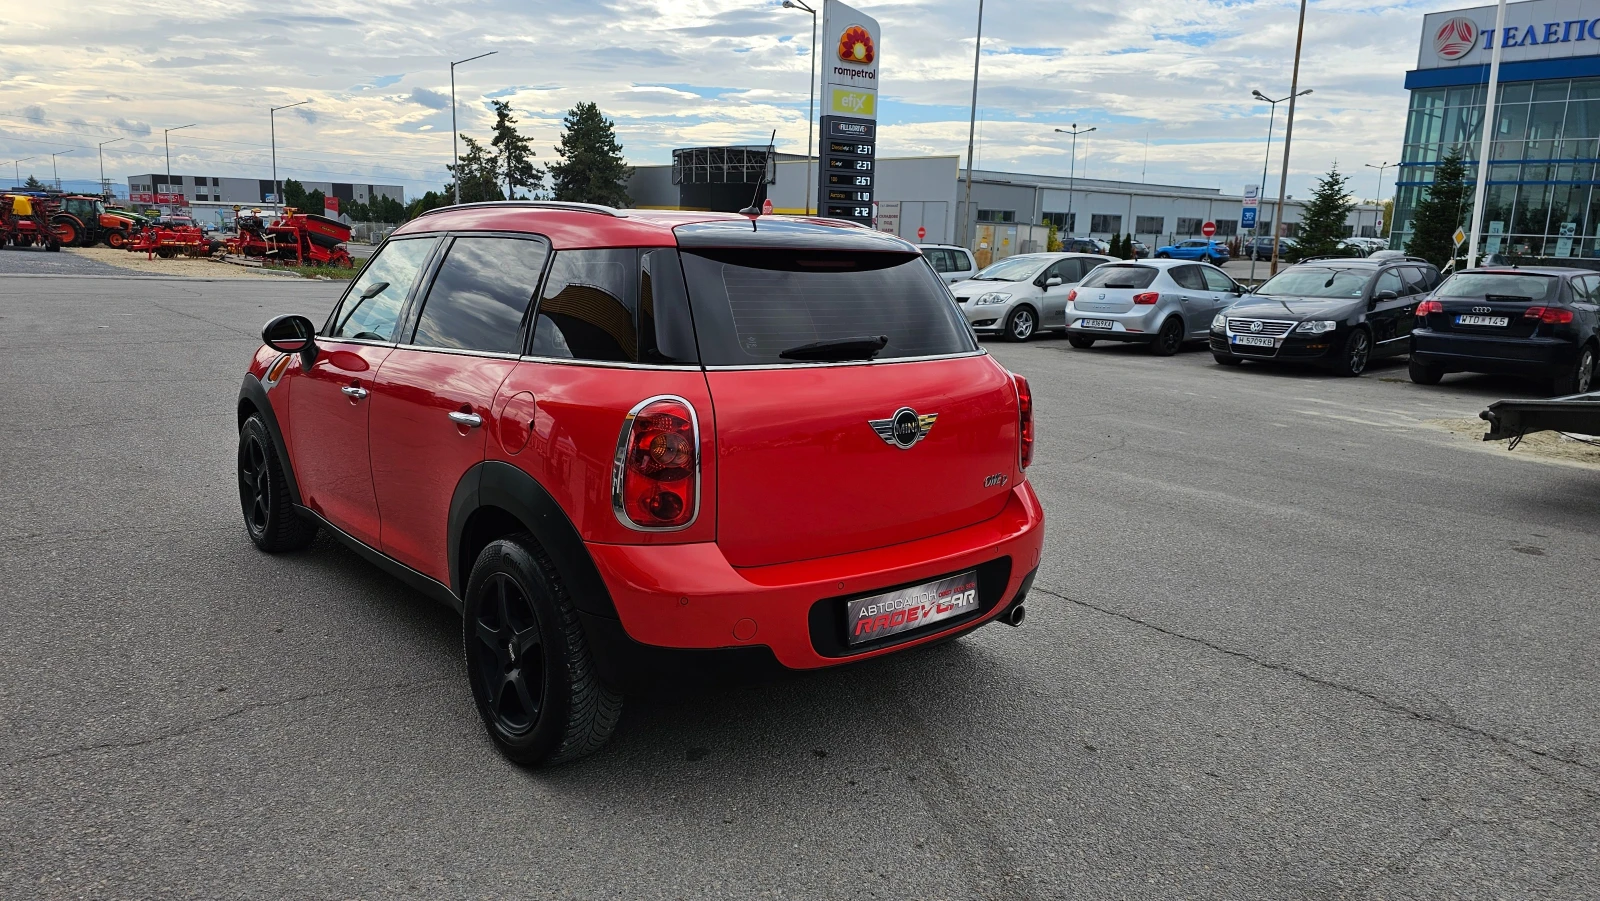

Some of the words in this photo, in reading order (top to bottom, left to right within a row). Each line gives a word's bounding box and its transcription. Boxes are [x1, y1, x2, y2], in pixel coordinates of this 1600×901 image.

[833, 66, 876, 79] rompetrol
[841, 93, 867, 112] efix
[895, 421, 918, 435] MINI
[858, 589, 937, 618] АВТОСАЛОН
